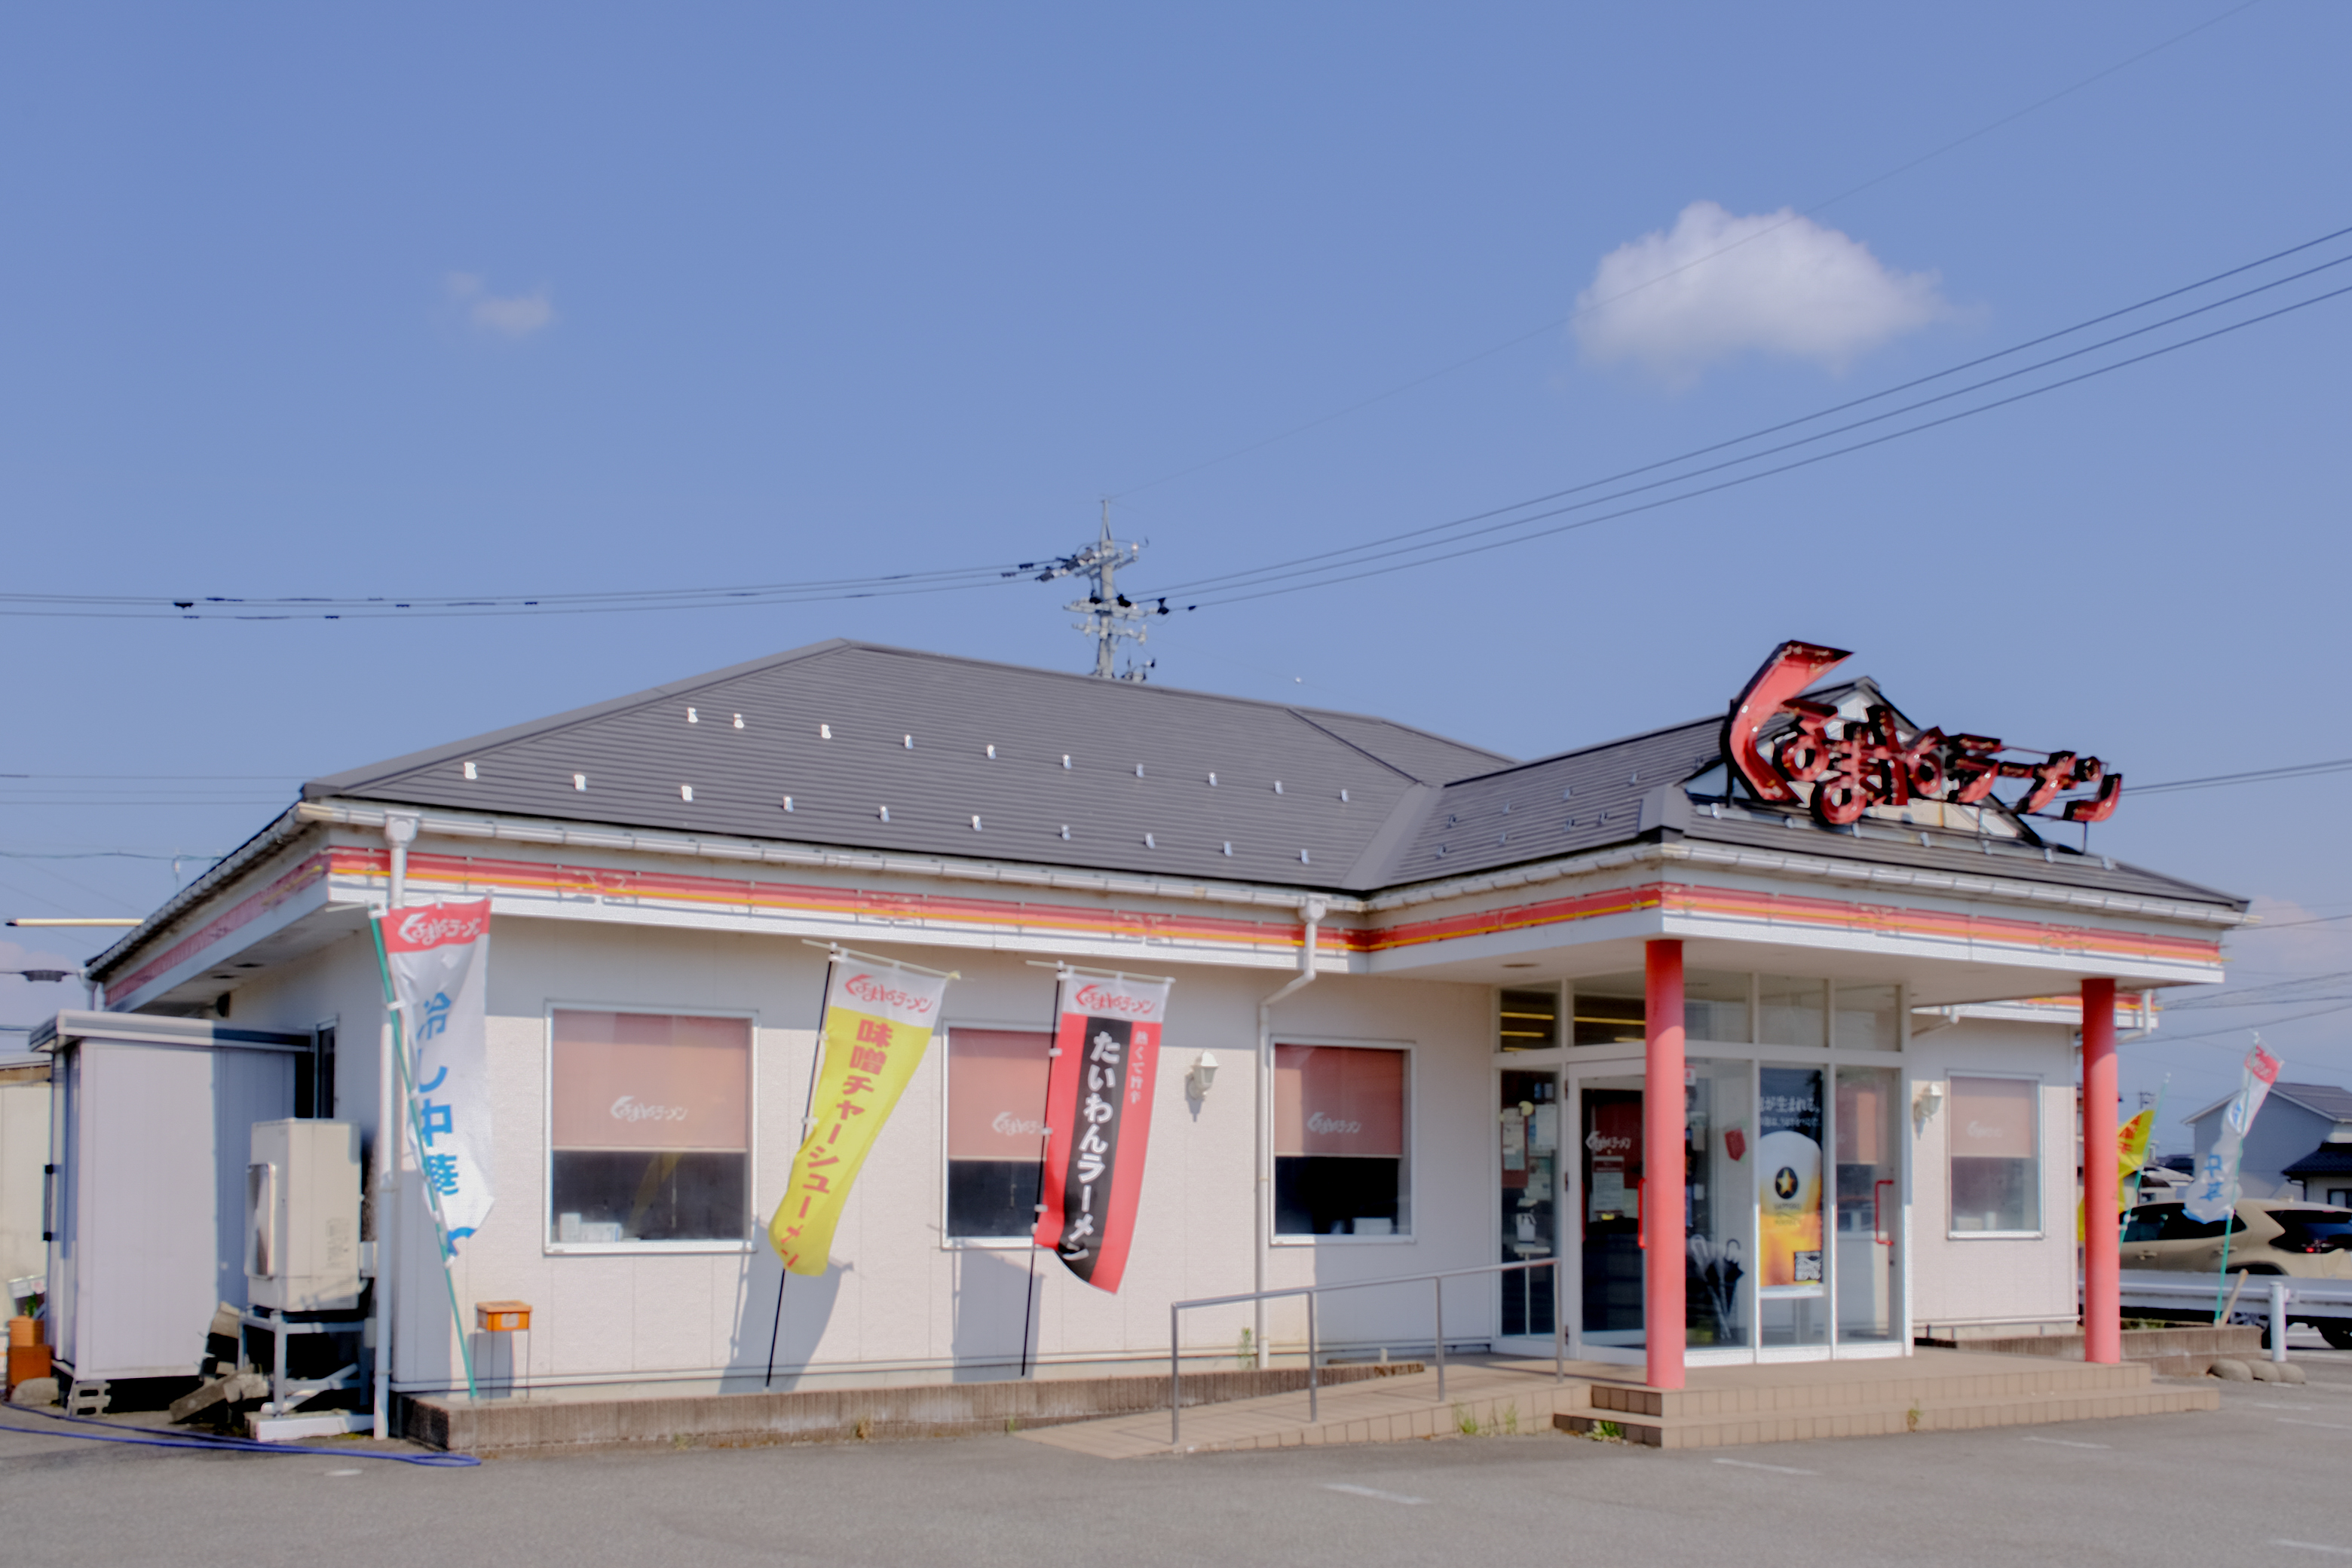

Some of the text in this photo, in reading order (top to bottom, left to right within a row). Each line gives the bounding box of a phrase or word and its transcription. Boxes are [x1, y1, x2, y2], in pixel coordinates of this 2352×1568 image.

[1722, 639, 2122, 825] くるまやラーメン
[845, 973, 934, 1012] くるまやラーメン
[1075, 985, 1156, 1015] くるまやラーメン
[1062, 1031, 1120, 1260] たいわんラーメン
